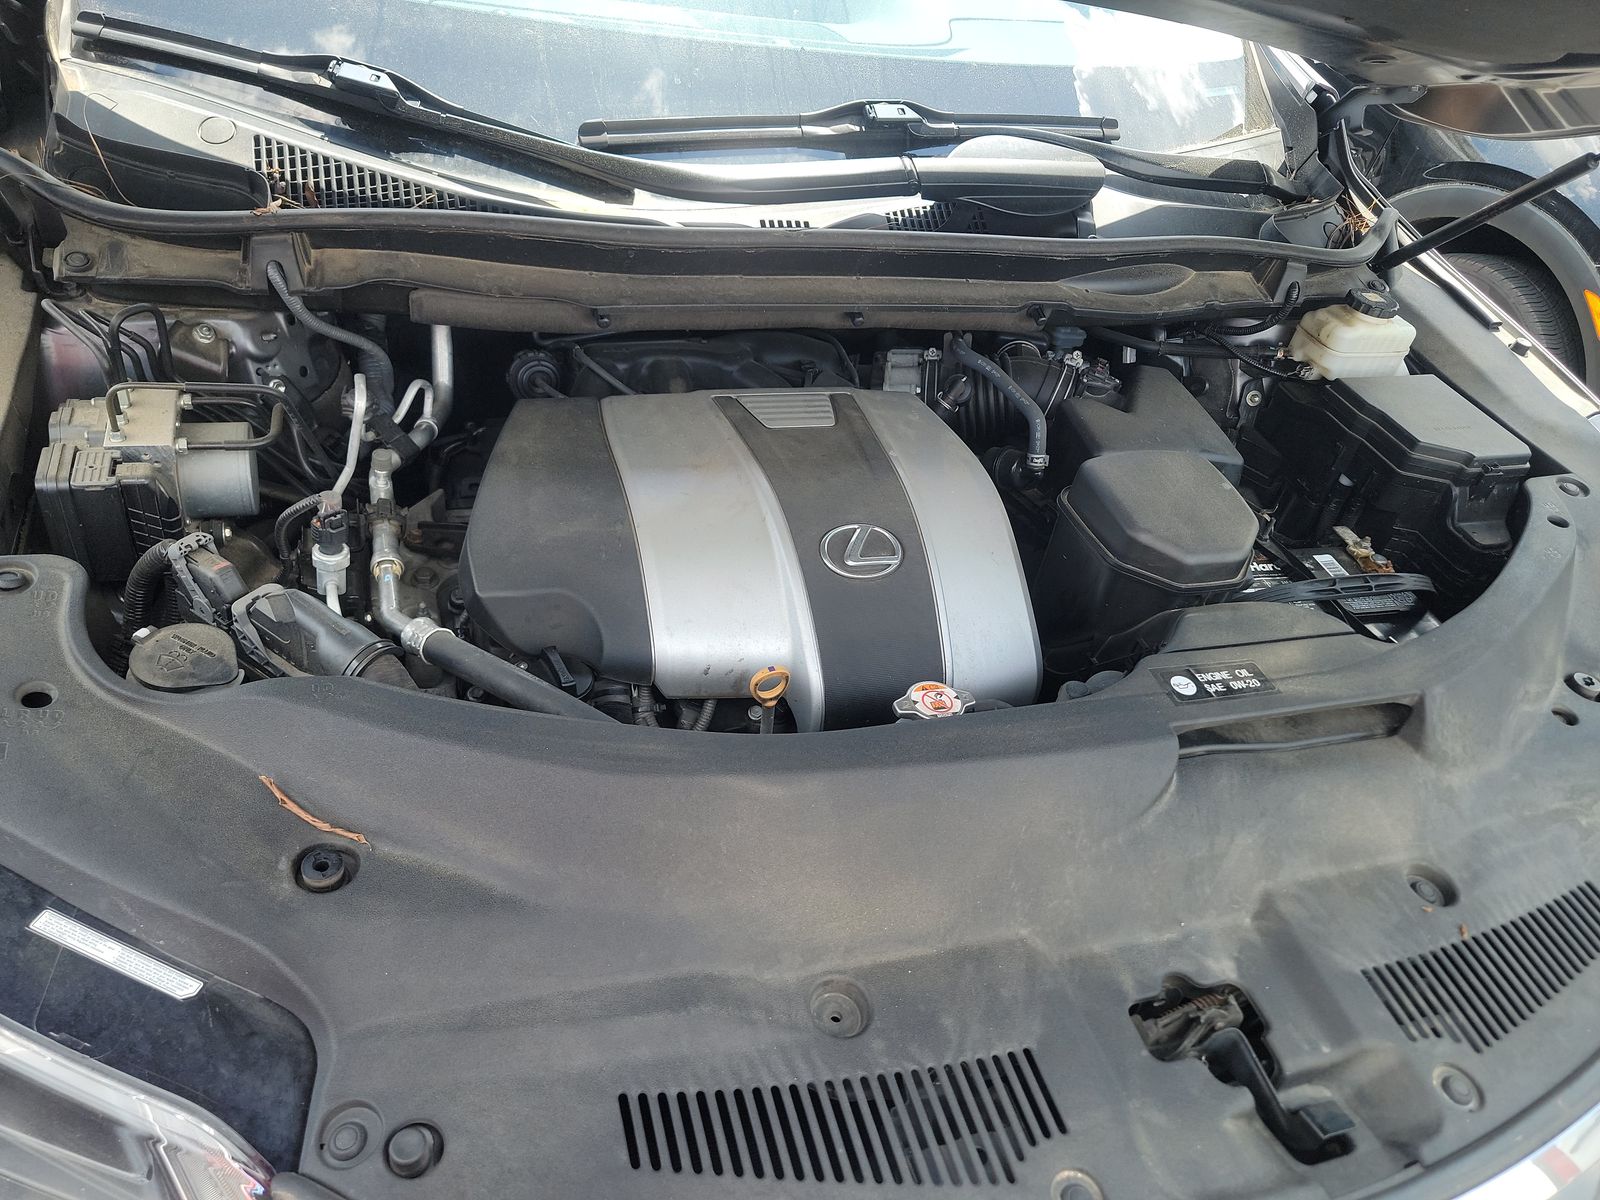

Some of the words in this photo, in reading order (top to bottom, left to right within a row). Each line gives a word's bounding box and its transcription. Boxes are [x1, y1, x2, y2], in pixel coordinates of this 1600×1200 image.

[1195, 670, 1233, 682] ENGINE
[1235, 668, 1254, 678] OIL
[1203, 683, 1227, 693] SAE
[1229, 679, 1261, 690] 0W-20
